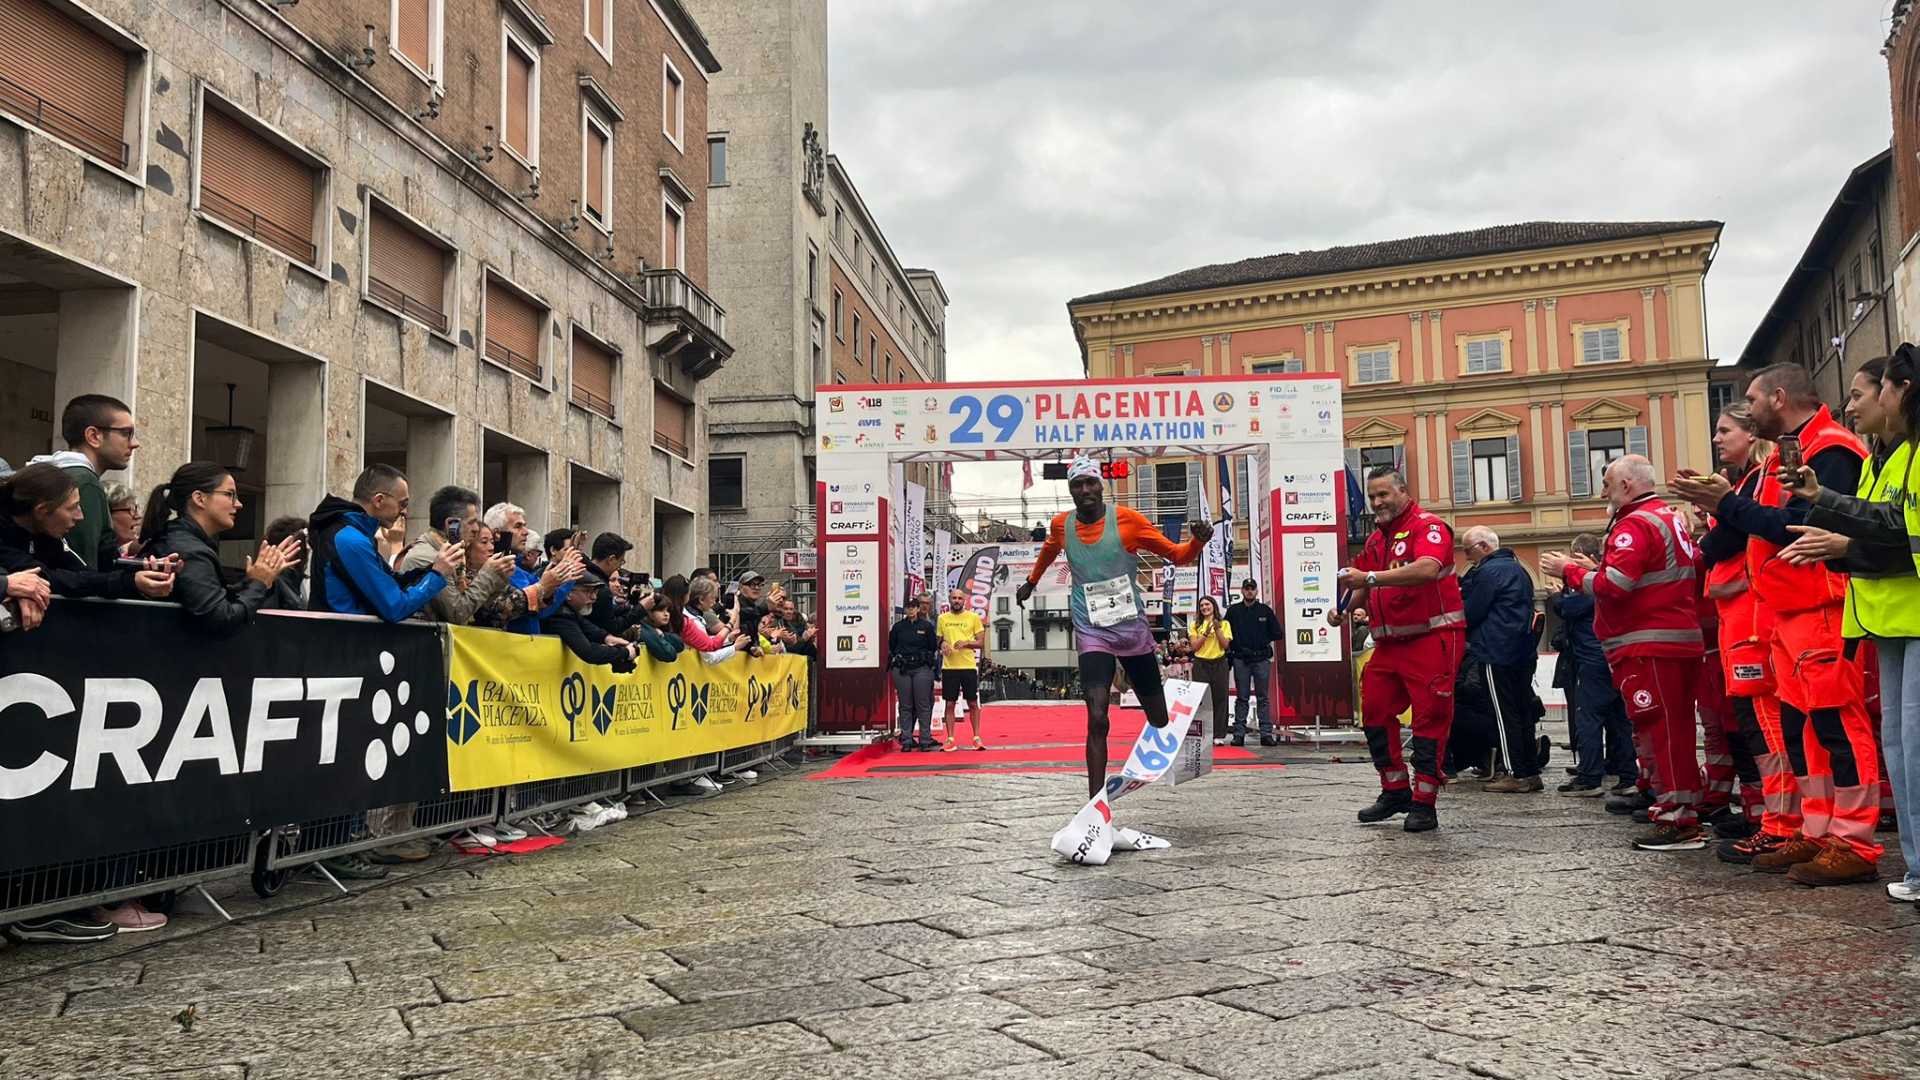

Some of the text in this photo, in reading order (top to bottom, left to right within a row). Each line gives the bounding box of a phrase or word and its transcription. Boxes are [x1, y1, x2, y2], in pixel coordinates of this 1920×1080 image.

[949, 394, 1023, 443] 29
[1035, 390, 1204, 420] PLACENTIA
[1036, 421, 1205, 442] HALF MARATHON
[843, 571, 862, 580] iren
[1300, 562, 1320, 572] iren
[1108, 597, 1116, 608] 3
[1302, 608, 1322, 617] LTP
[843, 615, 863, 624] LTP
[528, 683, 540, 704] DI
[483, 704, 547, 726] PIACENZA
[0, 673, 363, 799] CRAFT
[1135, 725, 1178, 771] 29
